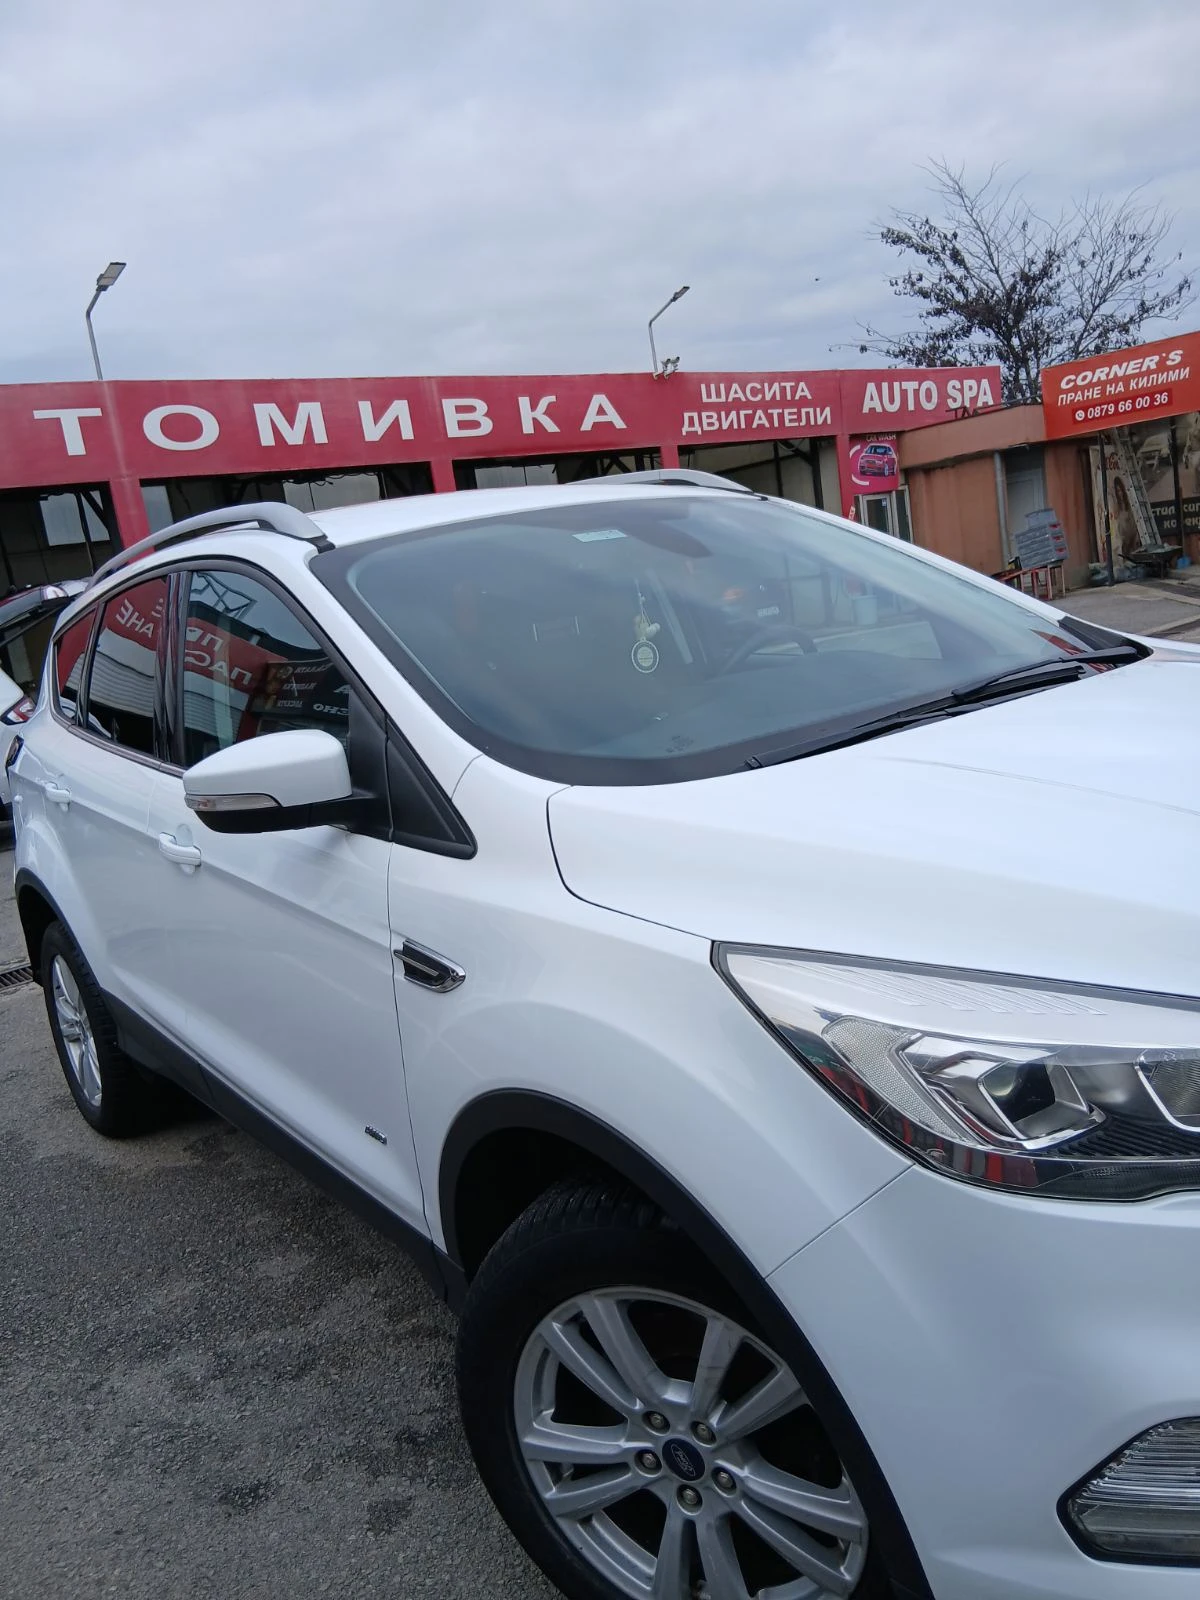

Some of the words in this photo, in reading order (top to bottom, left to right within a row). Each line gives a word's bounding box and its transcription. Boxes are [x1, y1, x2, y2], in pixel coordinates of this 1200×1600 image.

[700, 381, 812, 403] ШАСИТА
[862, 380, 938, 413] AUTO
[946, 378, 994, 408] SPA
[1057, 386, 1102, 406] ПРАНЕ
[1106, 381, 1125, 396] НА
[1129, 366, 1191, 391] КИЛИМИ
[681, 406, 832, 436] ДВИГАТЕЛИ
[1087, 403, 1115, 419] 0879
[1118, 399, 1132, 412] 66
[1135, 397, 1151, 409] 00
[1154, 391, 1169, 405] 36
[33, 393, 627, 456] ТОМИВКА
